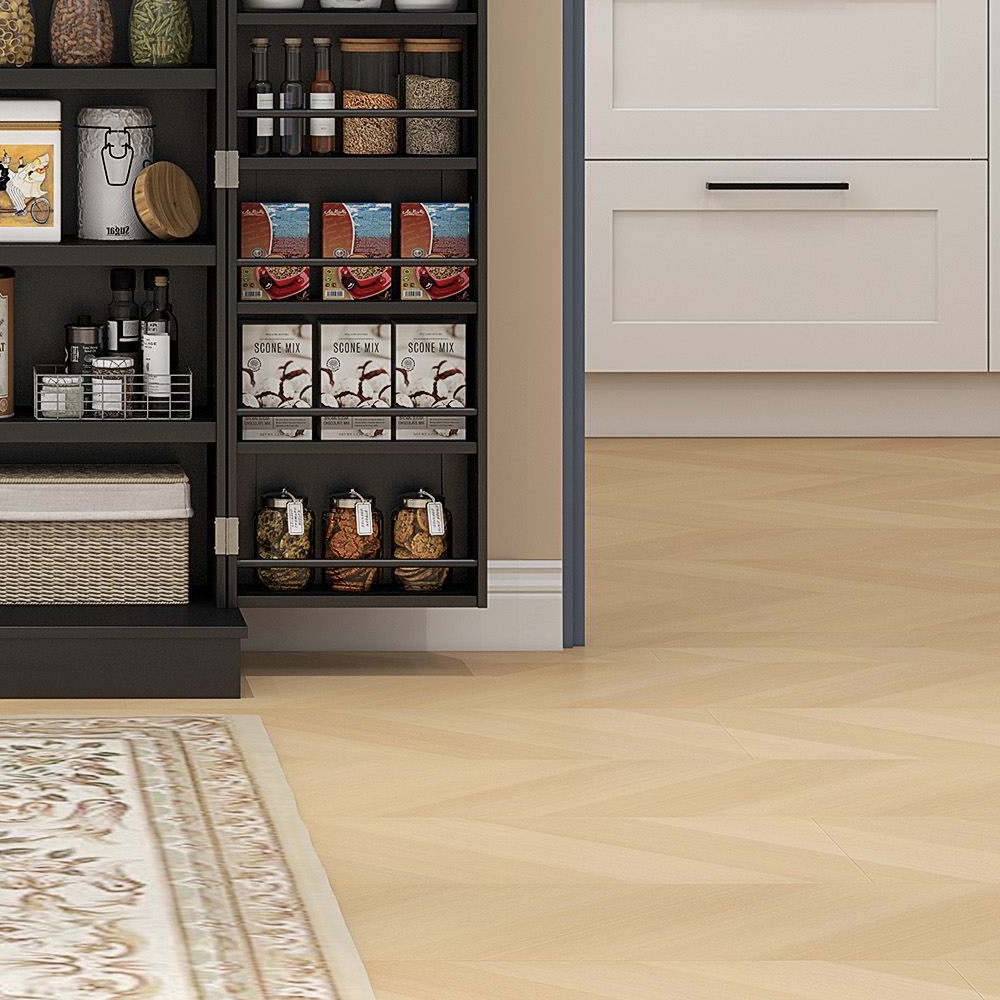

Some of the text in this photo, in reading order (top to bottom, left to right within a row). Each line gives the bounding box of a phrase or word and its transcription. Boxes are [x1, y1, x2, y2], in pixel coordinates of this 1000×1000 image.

[254, 342, 301, 353] SCONE MIX
[333, 342, 380, 353] SCONE MIX
[408, 342, 454, 353] SCONE MIX
